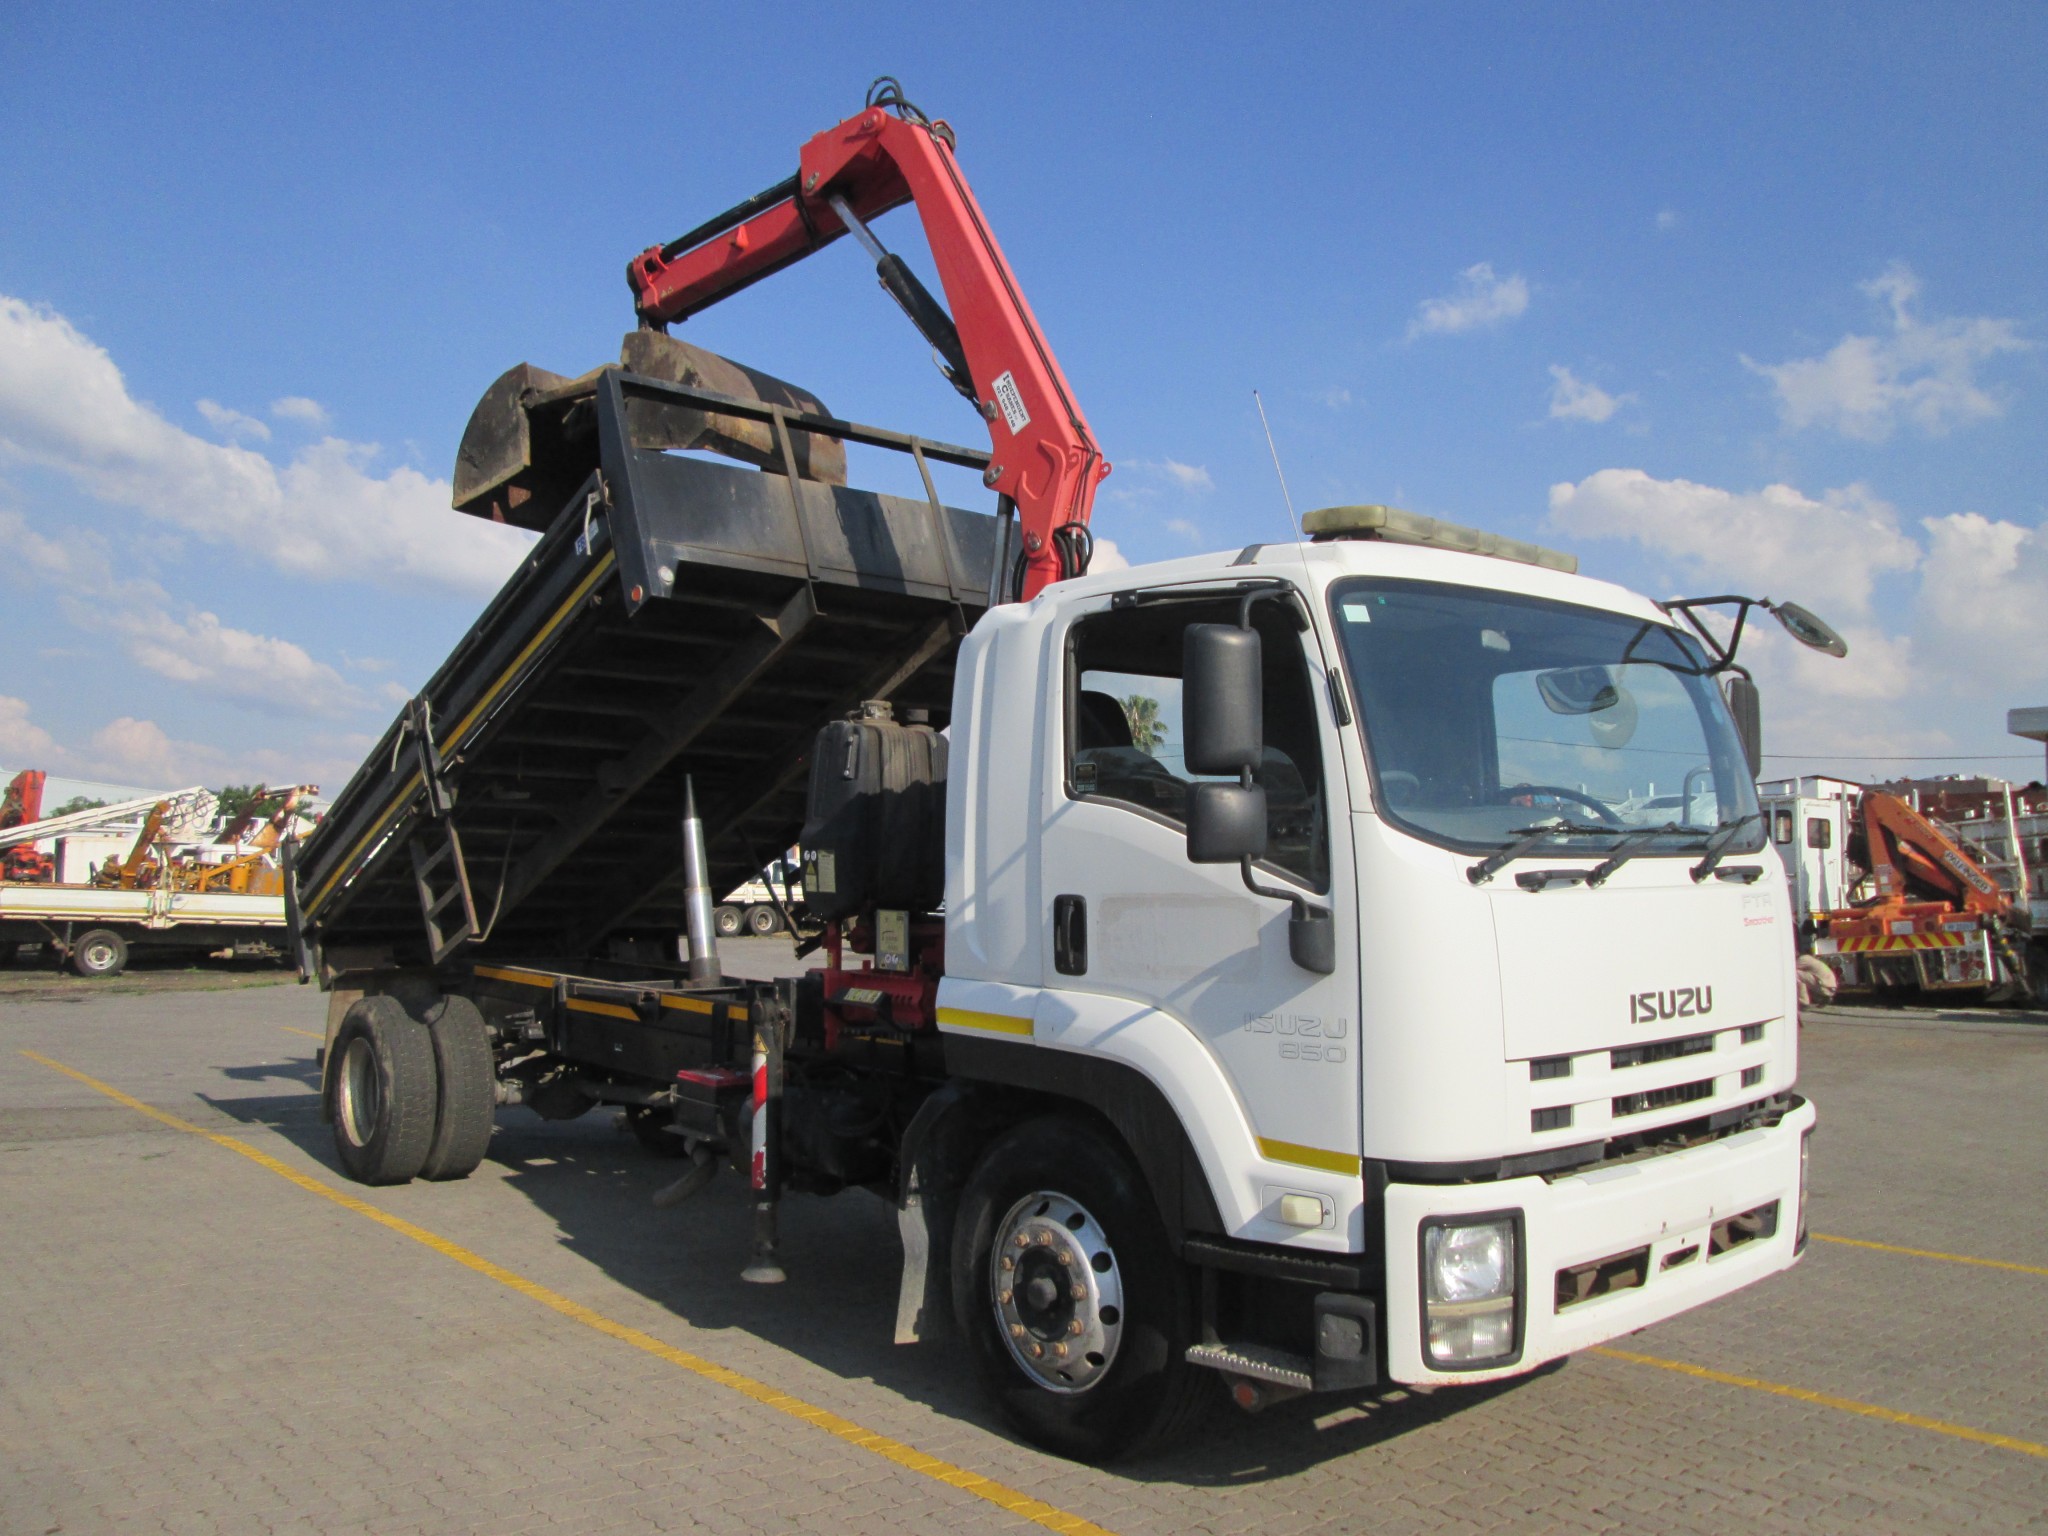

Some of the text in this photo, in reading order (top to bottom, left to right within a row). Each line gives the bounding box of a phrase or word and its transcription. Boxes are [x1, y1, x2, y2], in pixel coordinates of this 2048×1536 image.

[1003, 374, 1026, 421] INDEPENDENT
[1742, 892, 1773, 909] FTR
[1630, 985, 1712, 1024] ISUZU
[1243, 1013, 1347, 1039] ISUZU
[1279, 1041, 1347, 1063] 850
